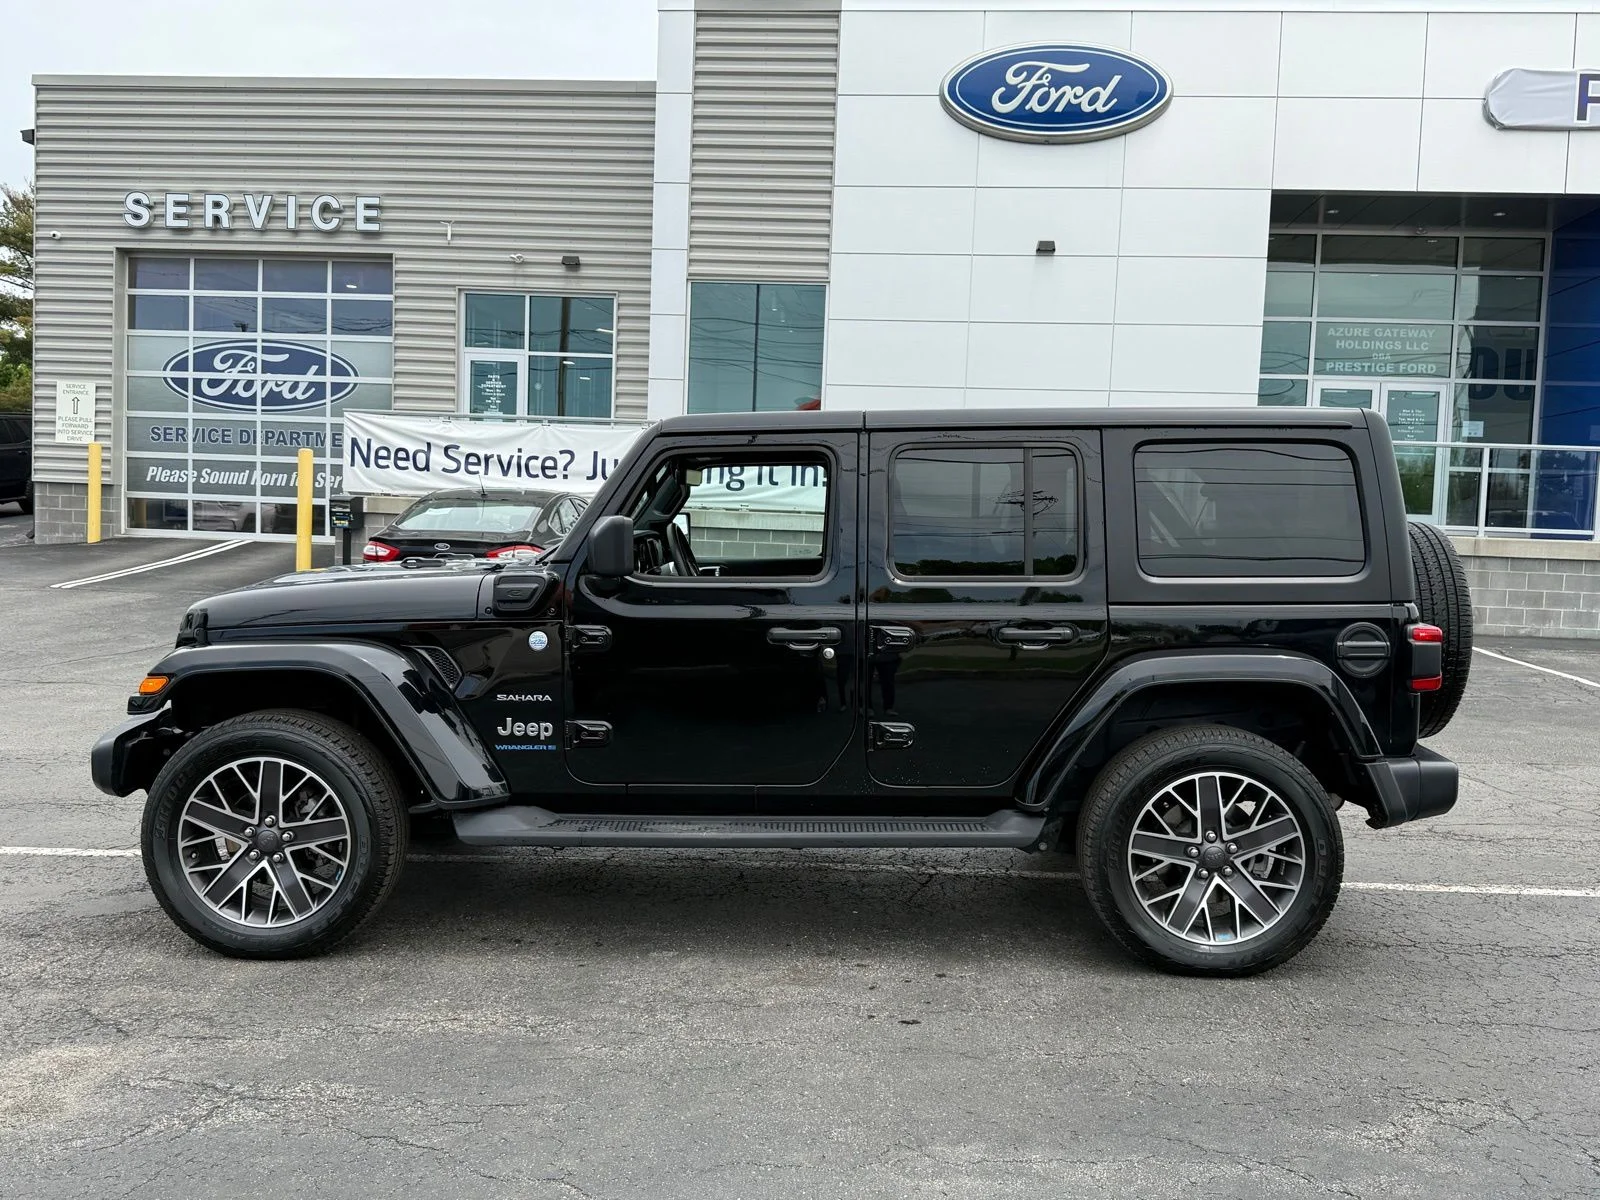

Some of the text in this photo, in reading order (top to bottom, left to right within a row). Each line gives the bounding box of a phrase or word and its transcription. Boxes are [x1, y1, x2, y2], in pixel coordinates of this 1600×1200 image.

[991, 61, 1122, 114] Ford
[124, 190, 382, 233] SERVICE
[1328, 328, 1436, 338] AZURE GATEWAY
[1336, 340, 1429, 351] HOLDINGS LLC
[200, 349, 320, 401] Ford
[1326, 362, 1437, 374] PRESTIGE FORD
[149, 426, 343, 448] SERVICE DEPARTME
[350, 437, 432, 473] Need
[441, 444, 576, 481] Service?
[586, 450, 619, 481] Ju
[146, 466, 198, 484] Please
[200, 468, 250, 485] Sound
[496, 694, 553, 702] SAHARA
[497, 717, 554, 740] Jeep
